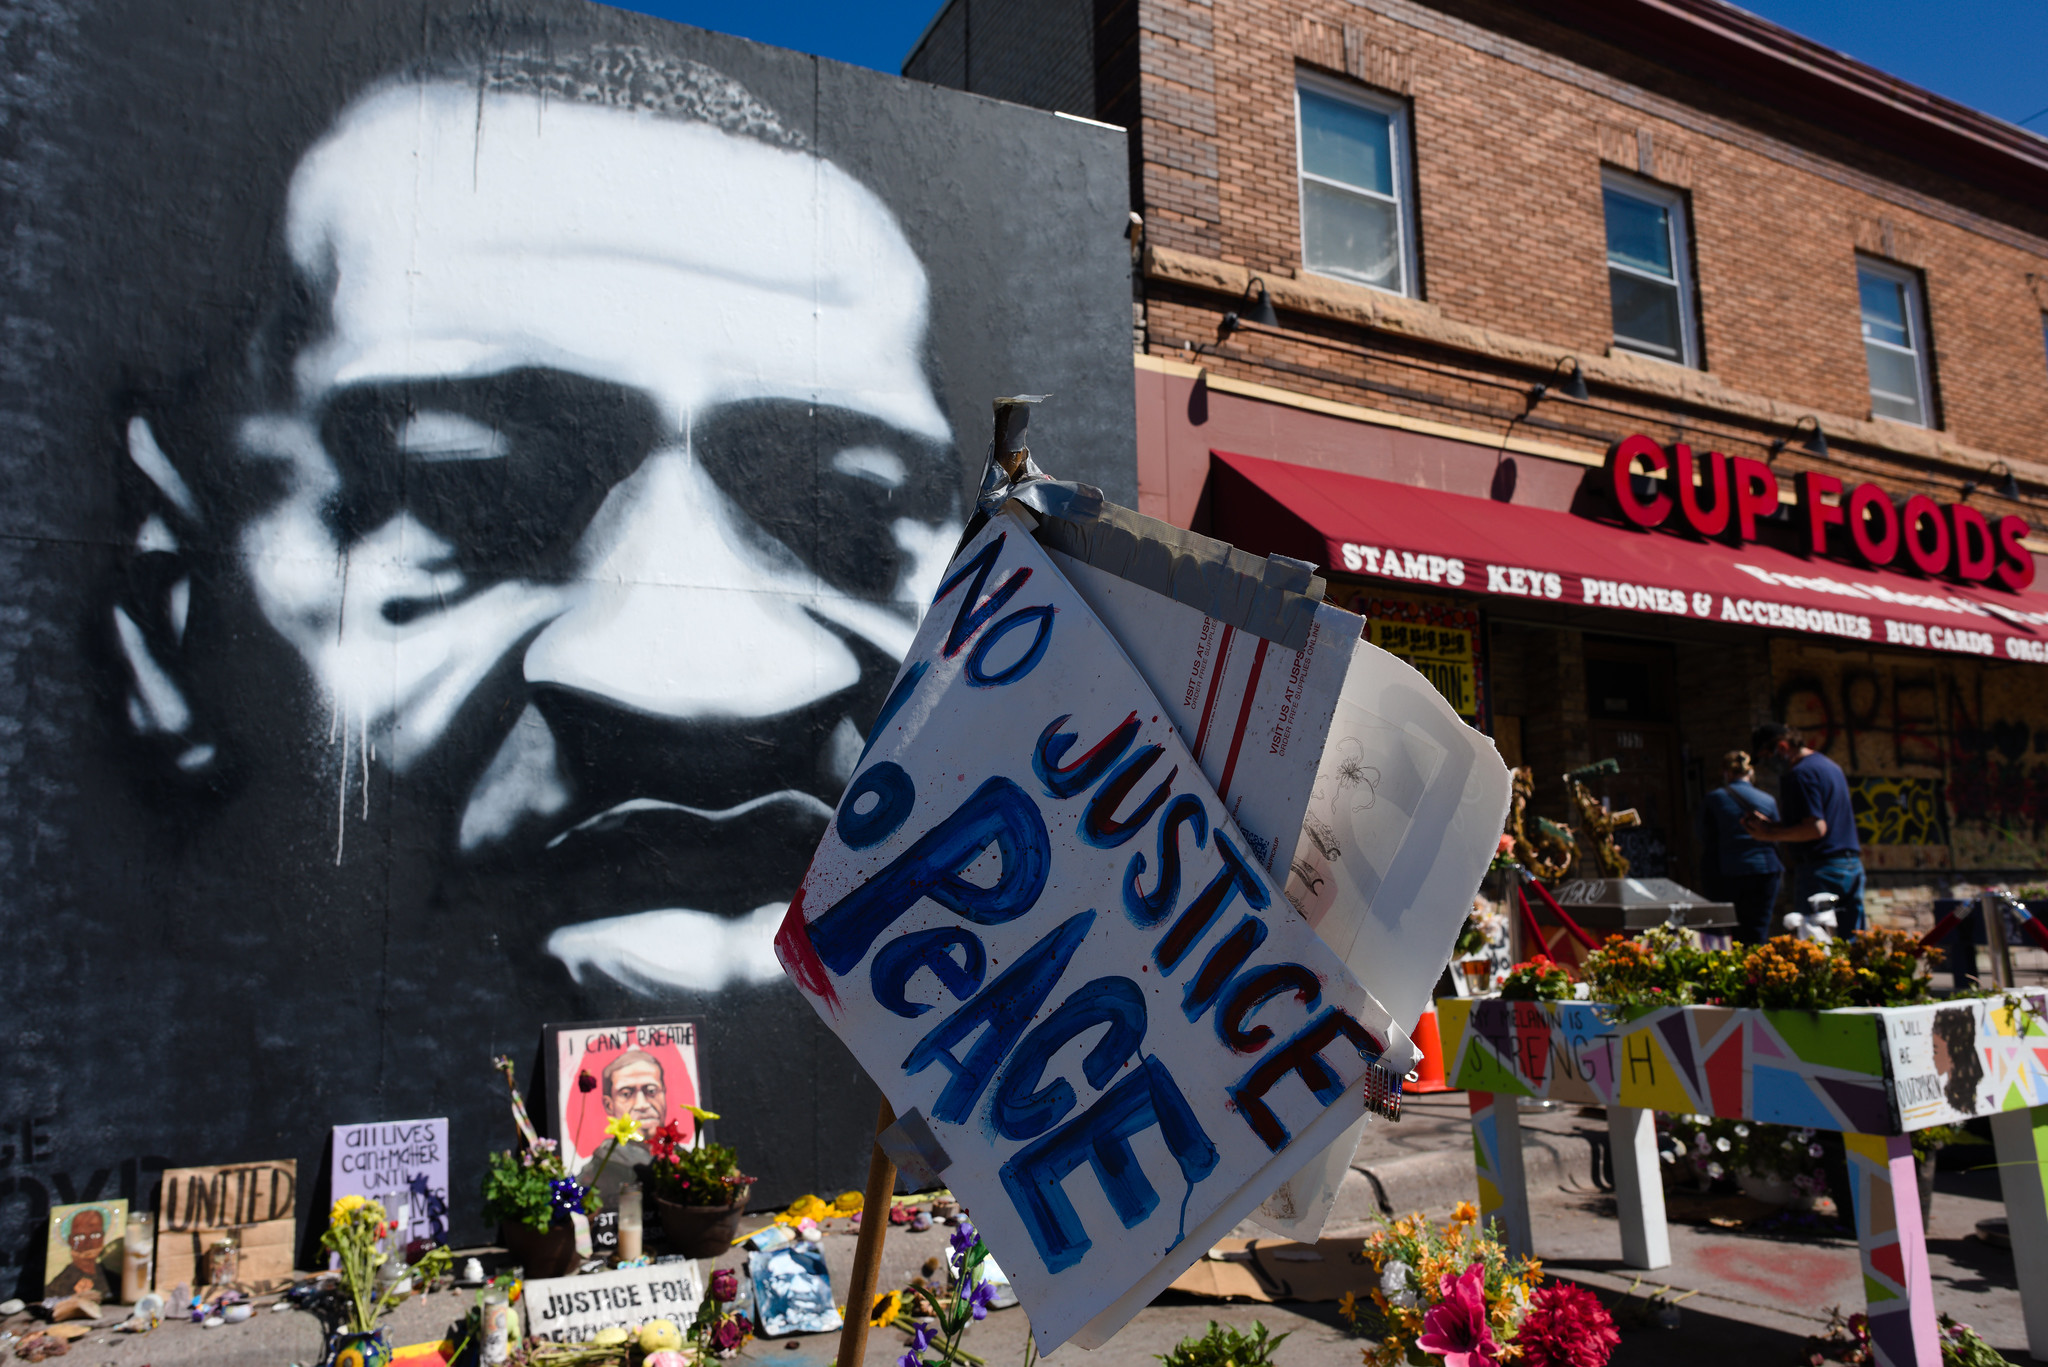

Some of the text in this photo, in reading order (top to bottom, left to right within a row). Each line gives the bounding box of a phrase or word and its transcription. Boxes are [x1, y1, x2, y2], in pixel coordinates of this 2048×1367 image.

[1613, 434, 2035, 589] CUP FOODS
[1341, 542, 1466, 586] STAMPS
[1486, 564, 1563, 599] KEYS
[1581, 577, 1688, 615] PHONES
[1692, 592, 1712, 617] &
[1720, 596, 1872, 640] ACCESSORIES
[1884, 619, 1927, 647] BUS
[1928, 626, 1994, 655] CARDS
[1184, 616, 1211, 706] VISIT US AT USP
[1190, 680, 1202, 710] ORDER
[1200, 658, 1208, 680] FREE
[1279, 622, 1321, 757] ORDER FREE SUPPLIES ONLINE
[1269, 723, 1284, 754] VISIT
[1278, 704, 1290, 722] US
[1284, 686, 1295, 704] AT
[1771, 667, 1987, 771] OPEN
[932, 531, 1386, 1154] NO JUSTICE
[637, 1025, 694, 1047] BREATHE
[1470, 1010, 1583, 1030] MY MELANIN IS
[1900, 1020, 1922, 1036] WILL
[1470, 1034, 1655, 1086] STRENGTH
[1899, 1047, 1912, 1064] BE
[1897, 1074, 1942, 1108] OUTSPOKEN
[167, 1166, 294, 1232] UNITED
[542, 1279, 693, 1320] JUSTICE FOR
